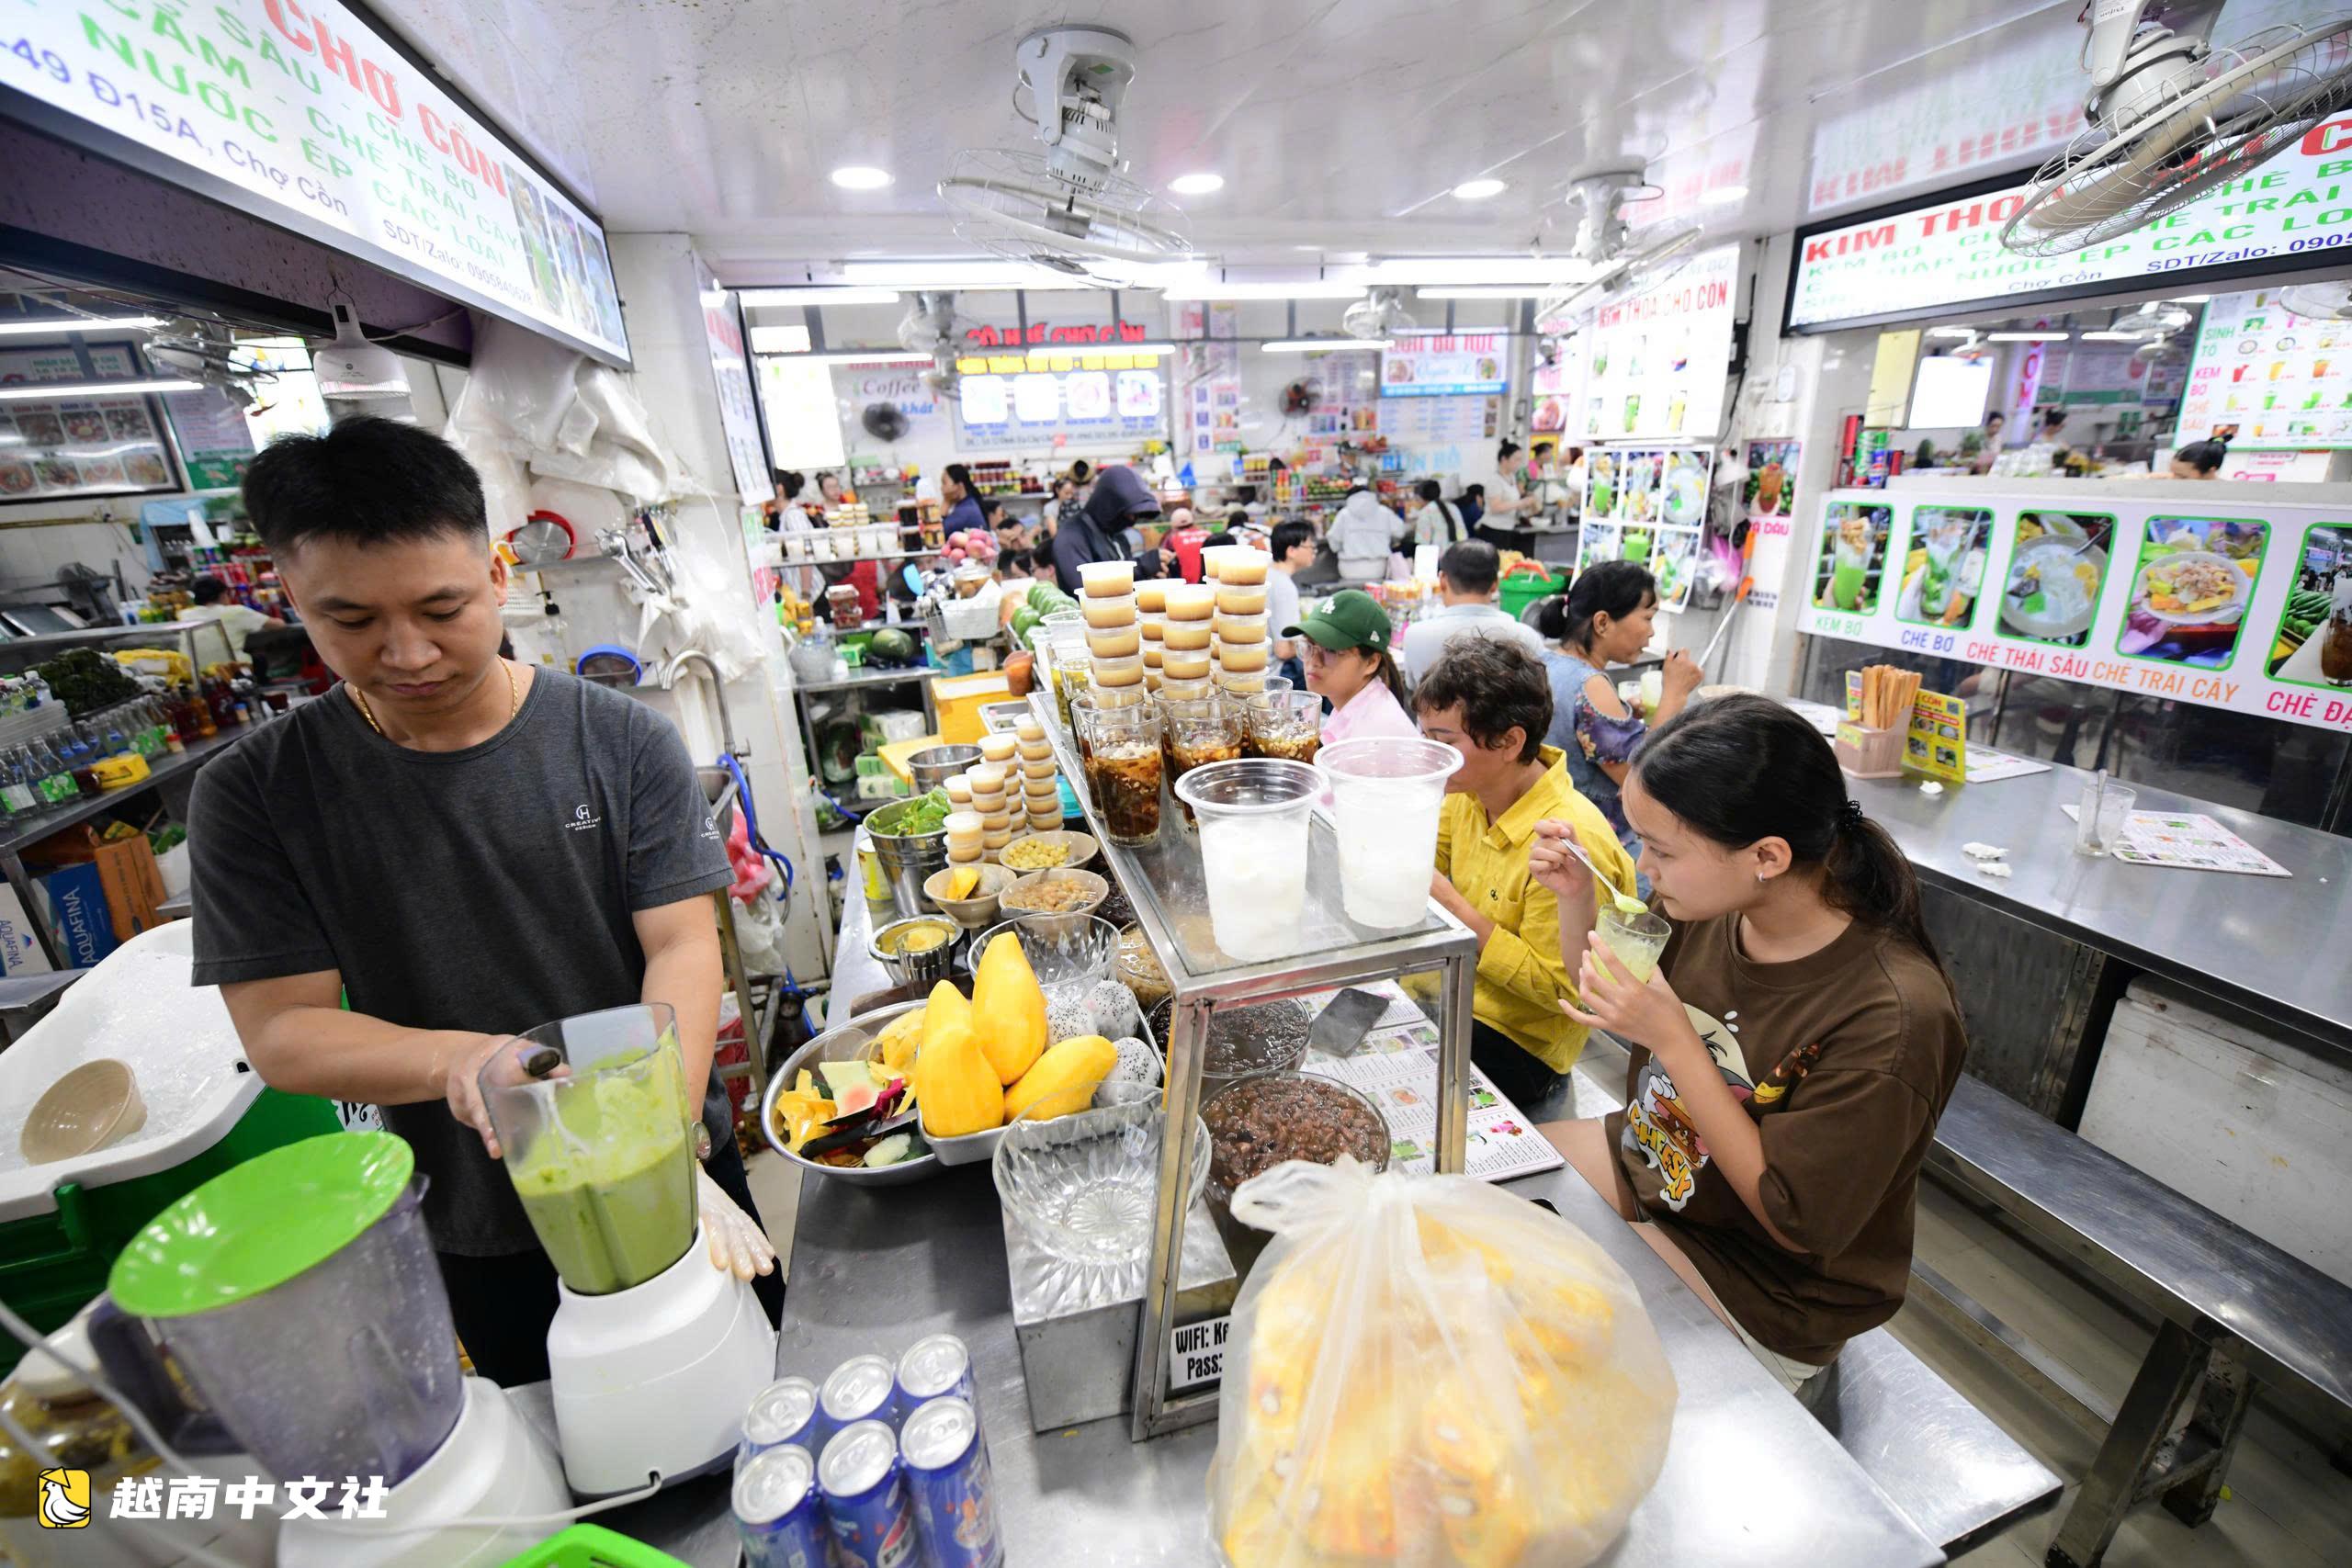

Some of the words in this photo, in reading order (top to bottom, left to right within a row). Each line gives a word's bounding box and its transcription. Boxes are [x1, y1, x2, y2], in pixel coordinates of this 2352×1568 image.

[2205, 171, 2290, 200] HÈ
[1805, 223, 1896, 264] KIM
[1917, 184, 2065, 237] THO
[1815, 616, 1838, 634] KEM
[1932, 635, 1955, 652] BƠ
[2004, 645, 2045, 670] THÁI
[2138, 669, 2186, 694] TRÁI
[2190, 677, 2241, 703] CÂY
[2266, 691, 2318, 718] CHÈ
[62, 884, 101, 965] AQUAFINA
[0, 919, 24, 971] AQUAFINA
[1630, 1103, 1692, 1202] CHEESY
[1175, 1325, 1210, 1355] WIFI:
[1187, 1352, 1224, 1381] Pass:
